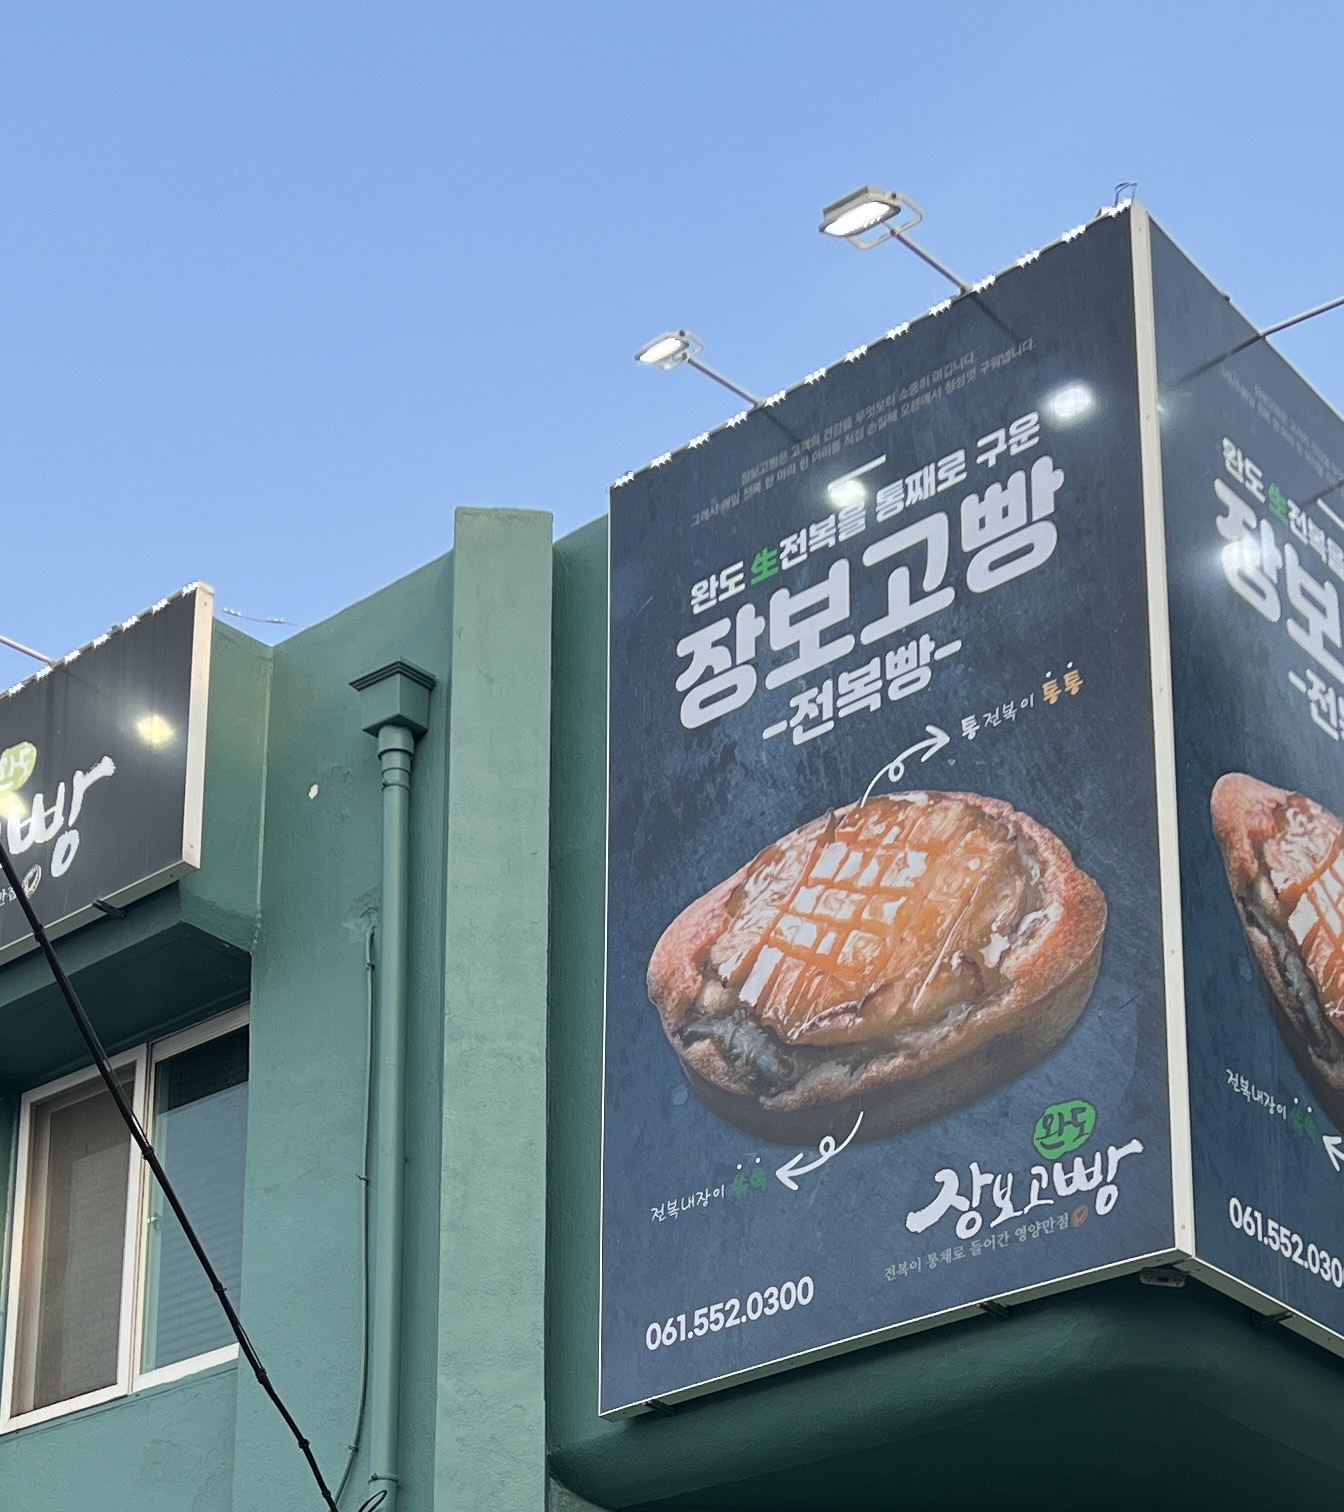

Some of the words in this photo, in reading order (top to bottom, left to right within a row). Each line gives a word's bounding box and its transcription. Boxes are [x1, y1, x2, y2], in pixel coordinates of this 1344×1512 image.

[1222, 437, 1266, 503] 완도
[690, 560, 746, 615] 완도
[875, 448, 968, 523] 통째로
[976, 411, 1041, 468] 구운
[674, 455, 1065, 729] 장보고빵
[1034, 1106, 1092, 1150] 완도
[650, 1184, 726, 1222] 전복내장이
[906, 1138, 1145, 1240] 장보고빵
[884, 1256, 922, 1282] 전복이
[970, 1231, 1010, 1257] 들어간
[1015, 1212, 1069, 1242] 영양만점
[645, 1275, 814, 1351] 061.552.0300
